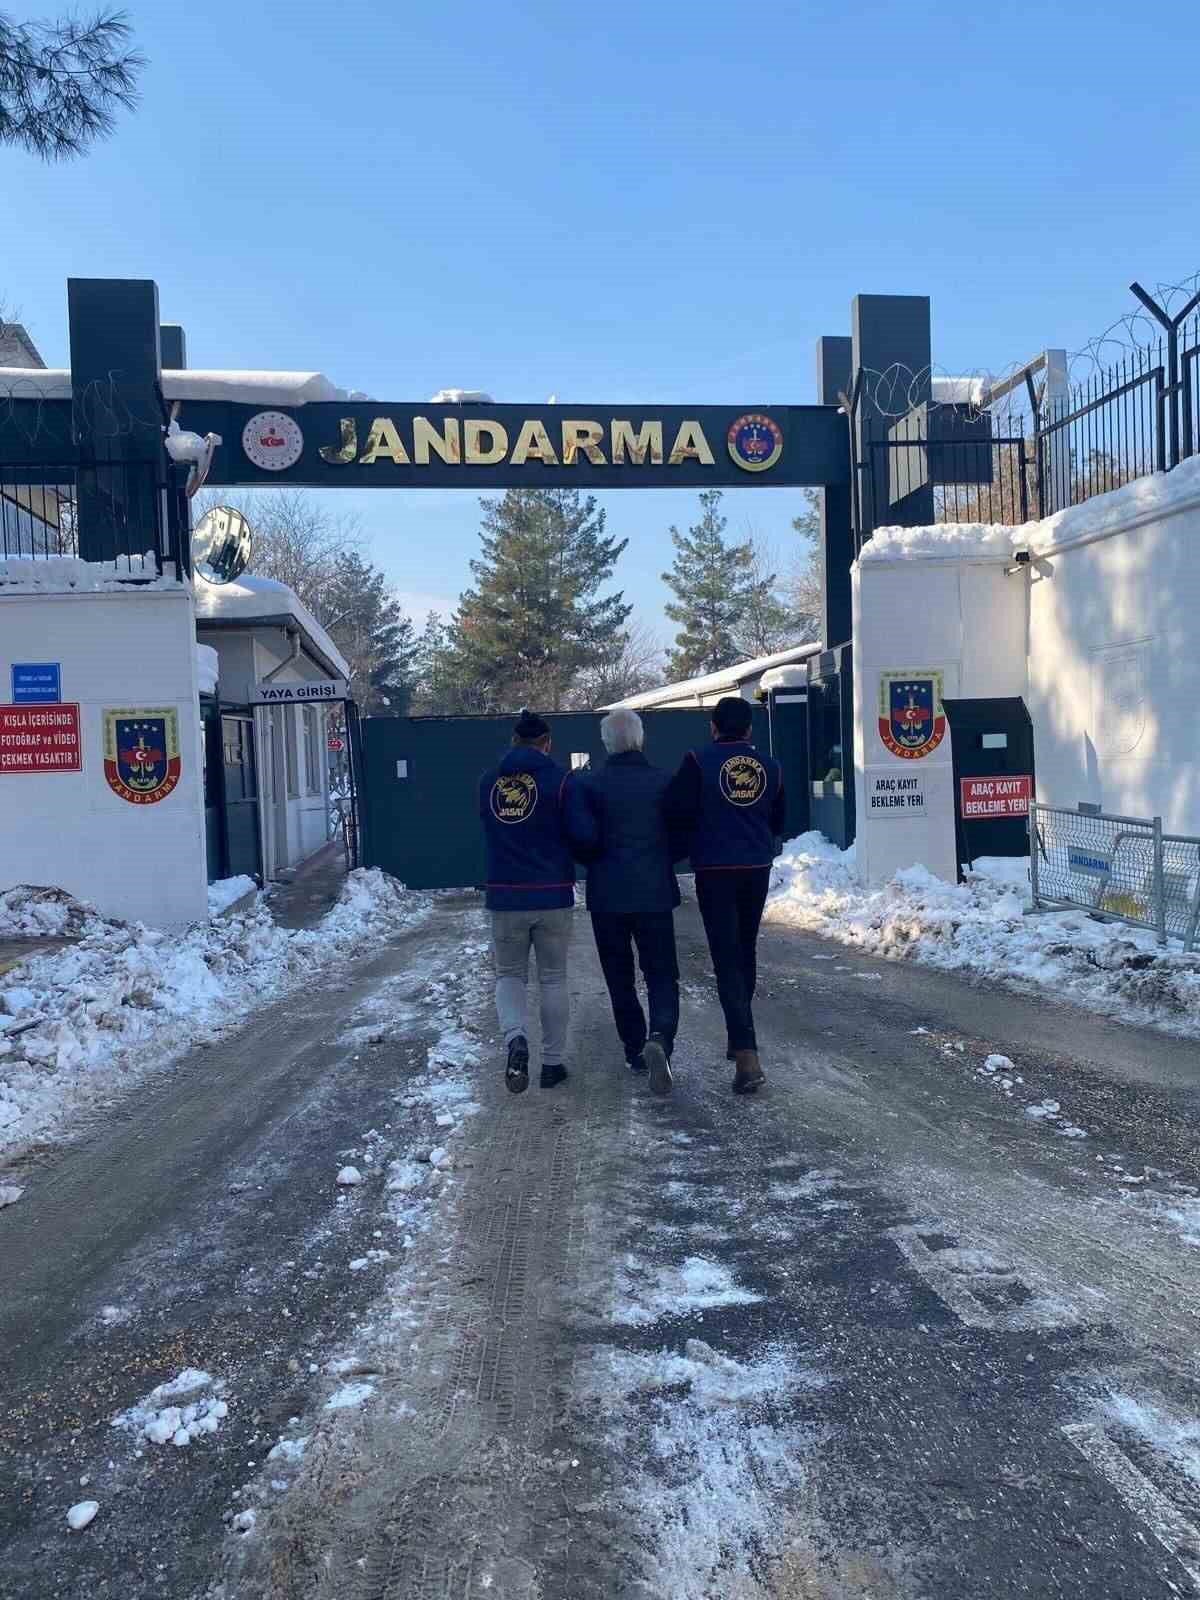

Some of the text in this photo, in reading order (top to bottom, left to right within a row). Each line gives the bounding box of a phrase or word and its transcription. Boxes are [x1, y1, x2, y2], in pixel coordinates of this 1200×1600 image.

[318, 416, 716, 465] JANDARMA
[261, 684, 336, 699] YAYA GİRİŞİ
[4, 711, 73, 727] KIŞLA İÇERİSİNDE
[1, 732, 41, 746] FOTOĞRAF
[54, 731, 76, 745] VİDEO
[1, 753, 33, 766] ÇEKMEK
[35, 751, 73, 764] YASAKTIR
[109, 775, 177, 802] JANDARMA
[875, 778, 918, 792] ARAÇ KAYIT
[971, 781, 1021, 797] ARAÇ KAYIT
[871, 791, 924, 808] BEKLEME YERİ
[966, 795, 1028, 814] BEKLEME YERİ
